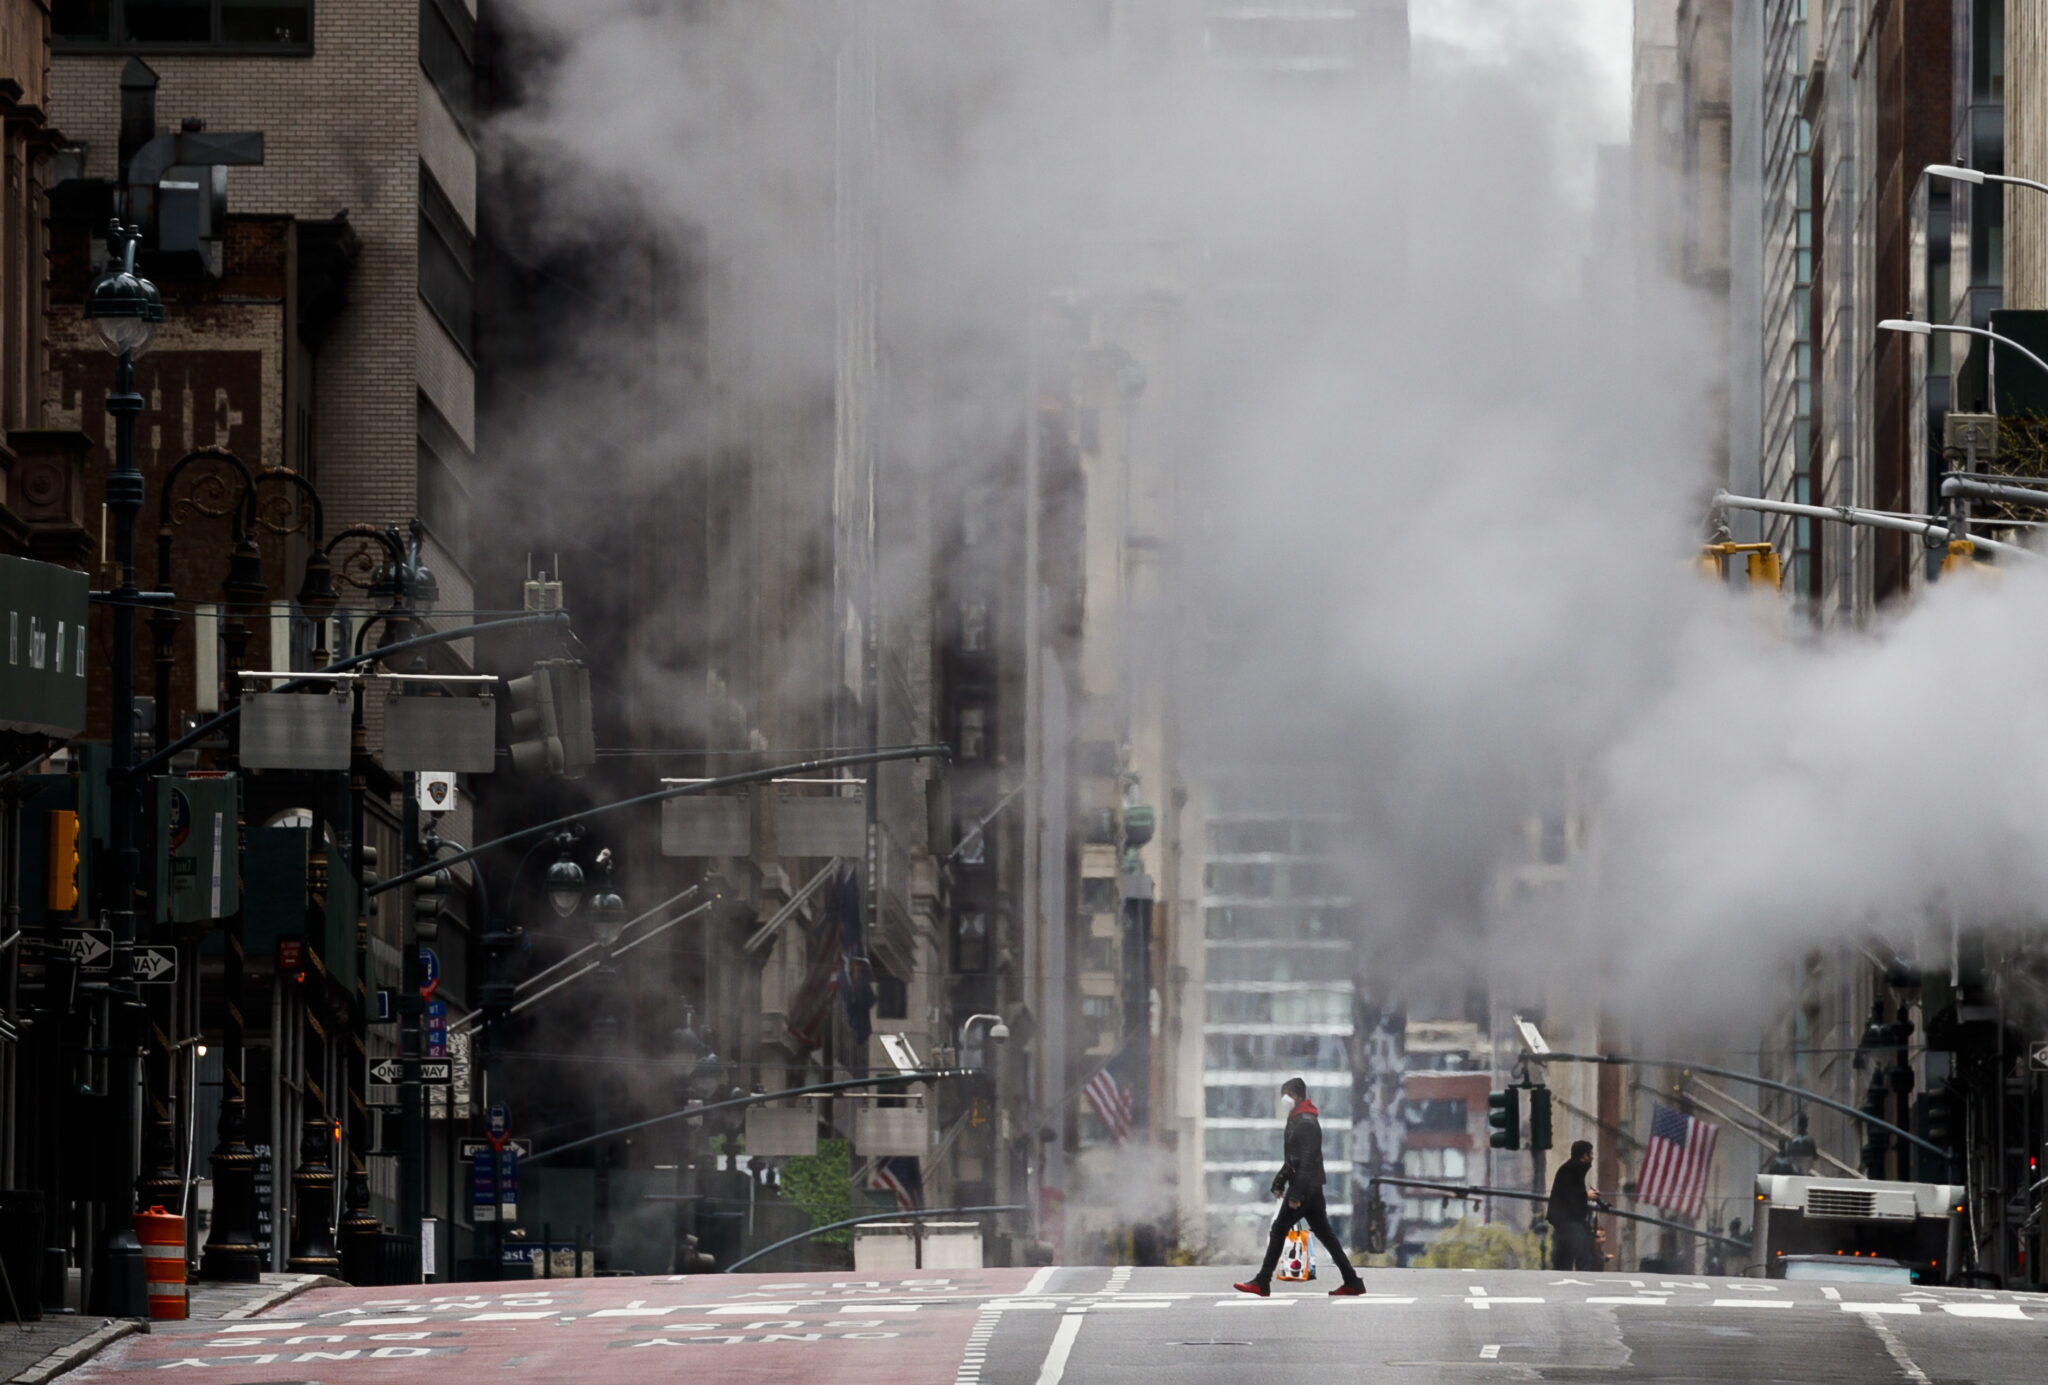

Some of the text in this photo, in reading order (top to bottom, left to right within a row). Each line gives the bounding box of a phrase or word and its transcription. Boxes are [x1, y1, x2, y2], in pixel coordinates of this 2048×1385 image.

[377, 1066, 404, 1077] ONE
[1548, 1278, 1779, 1292] ONLY
[204, 1331, 433, 1347] BUS
[632, 1332, 902, 1348] ONLY
[157, 1346, 432, 1369] ONLY
